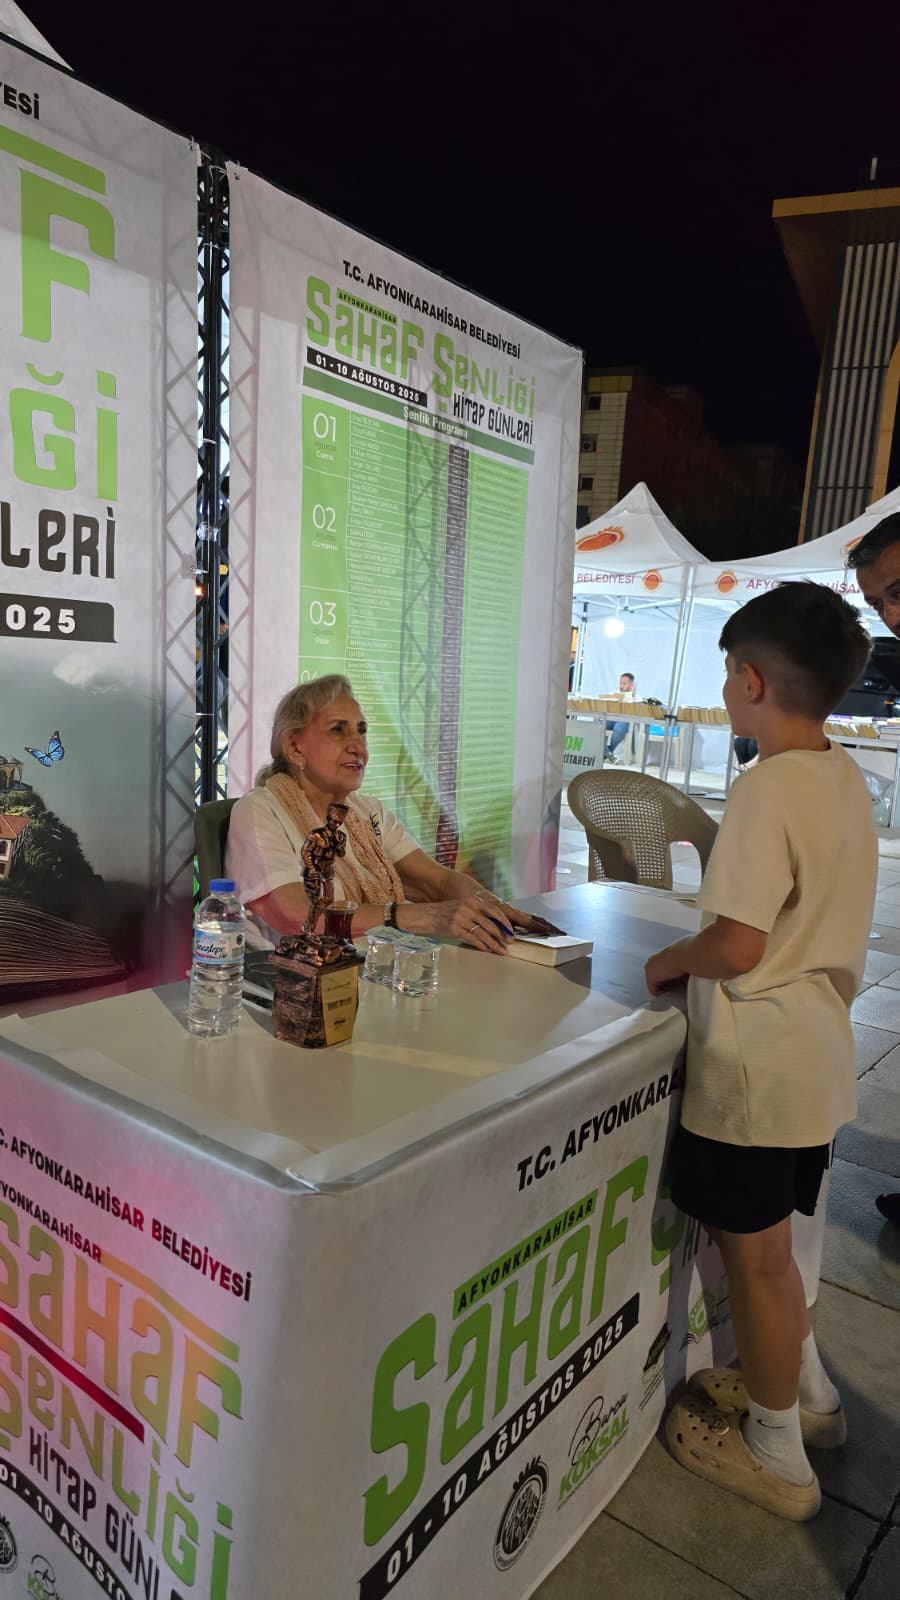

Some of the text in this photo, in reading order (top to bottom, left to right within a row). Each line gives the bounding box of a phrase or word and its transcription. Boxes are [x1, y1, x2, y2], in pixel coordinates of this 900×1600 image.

[0, 82, 39, 120] ESİ
[343, 259, 520, 359] T.C. AFYONKARAHİSAR BELEDİYESİ
[315, 354, 327, 368] 01
[337, 363, 348, 376] 10
[351, 368, 395, 392] AĞUSTOS
[398, 386, 420, 402] 2025
[313, 412, 336, 443] 01
[312, 503, 337, 533] 02
[309, 600, 337, 626] 03
[517, 1145, 556, 1192] T.C.
[11, 1136, 145, 1232] AFYONKARAHİSAR
[151, 1217, 252, 1301] BELEDİYESİ
[458, 1199, 594, 1313] AFYONKARAHİSAR
[387, 1532, 414, 1584] 01
[443, 1473, 468, 1517] 10
[477, 1363, 575, 1482] AĞUSTOS
[582, 1315, 623, 1373] 2025
[36, 1494, 53, 1524] 10
